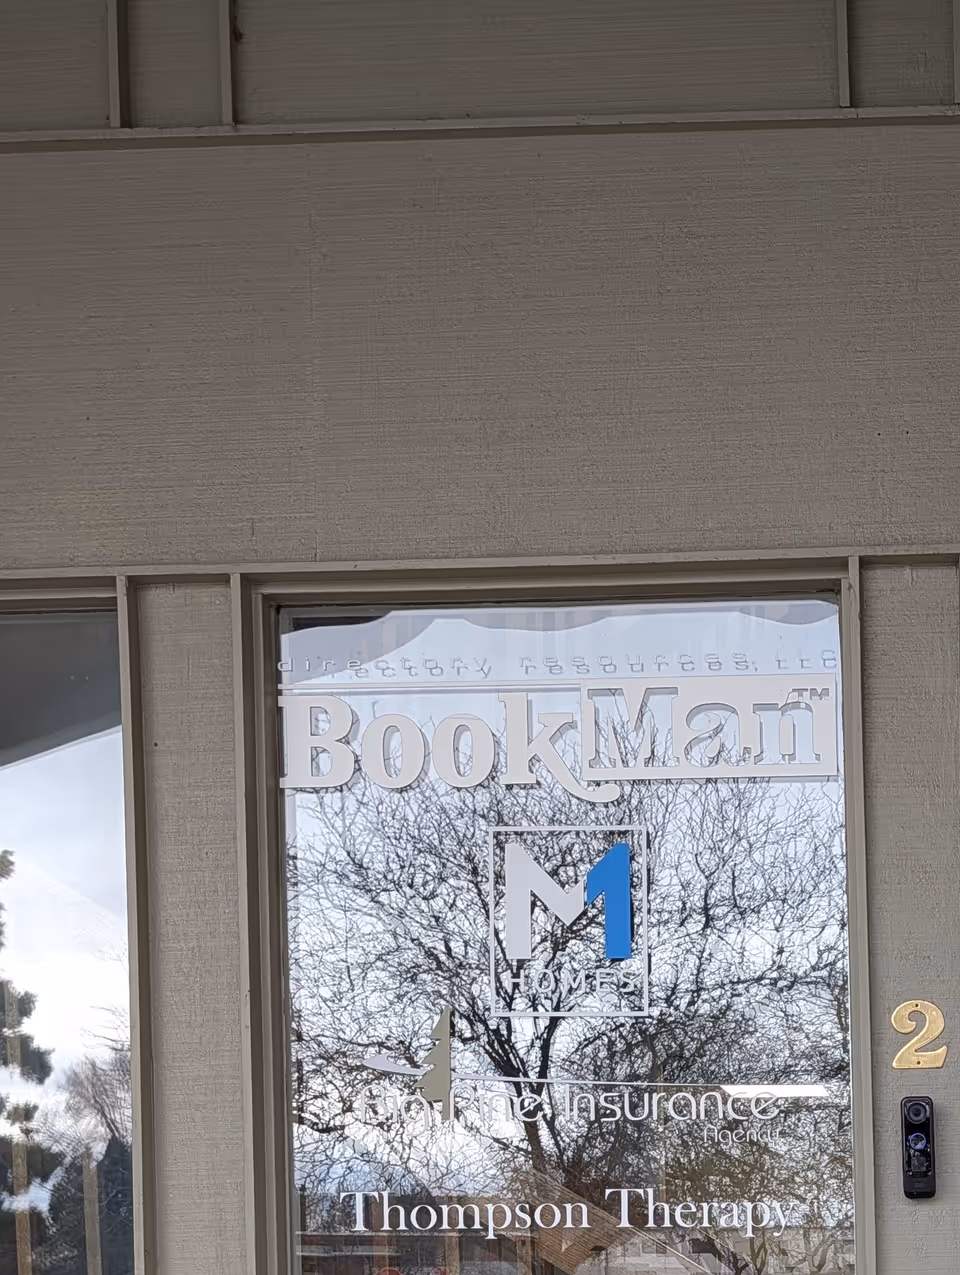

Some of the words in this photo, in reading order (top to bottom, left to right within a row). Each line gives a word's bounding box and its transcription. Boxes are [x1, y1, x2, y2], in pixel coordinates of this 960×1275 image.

[505, 843, 632, 959] M1
[507, 968, 636, 995] HOMES
[891, 999, 948, 1070] 2
[449, 1083, 544, 1122] Pine
[564, 1083, 781, 1122] Insurance
[703, 1124, 781, 1146] Agency
[339, 1191, 592, 1239] Thompson
[604, 1187, 800, 1237] Therapy
